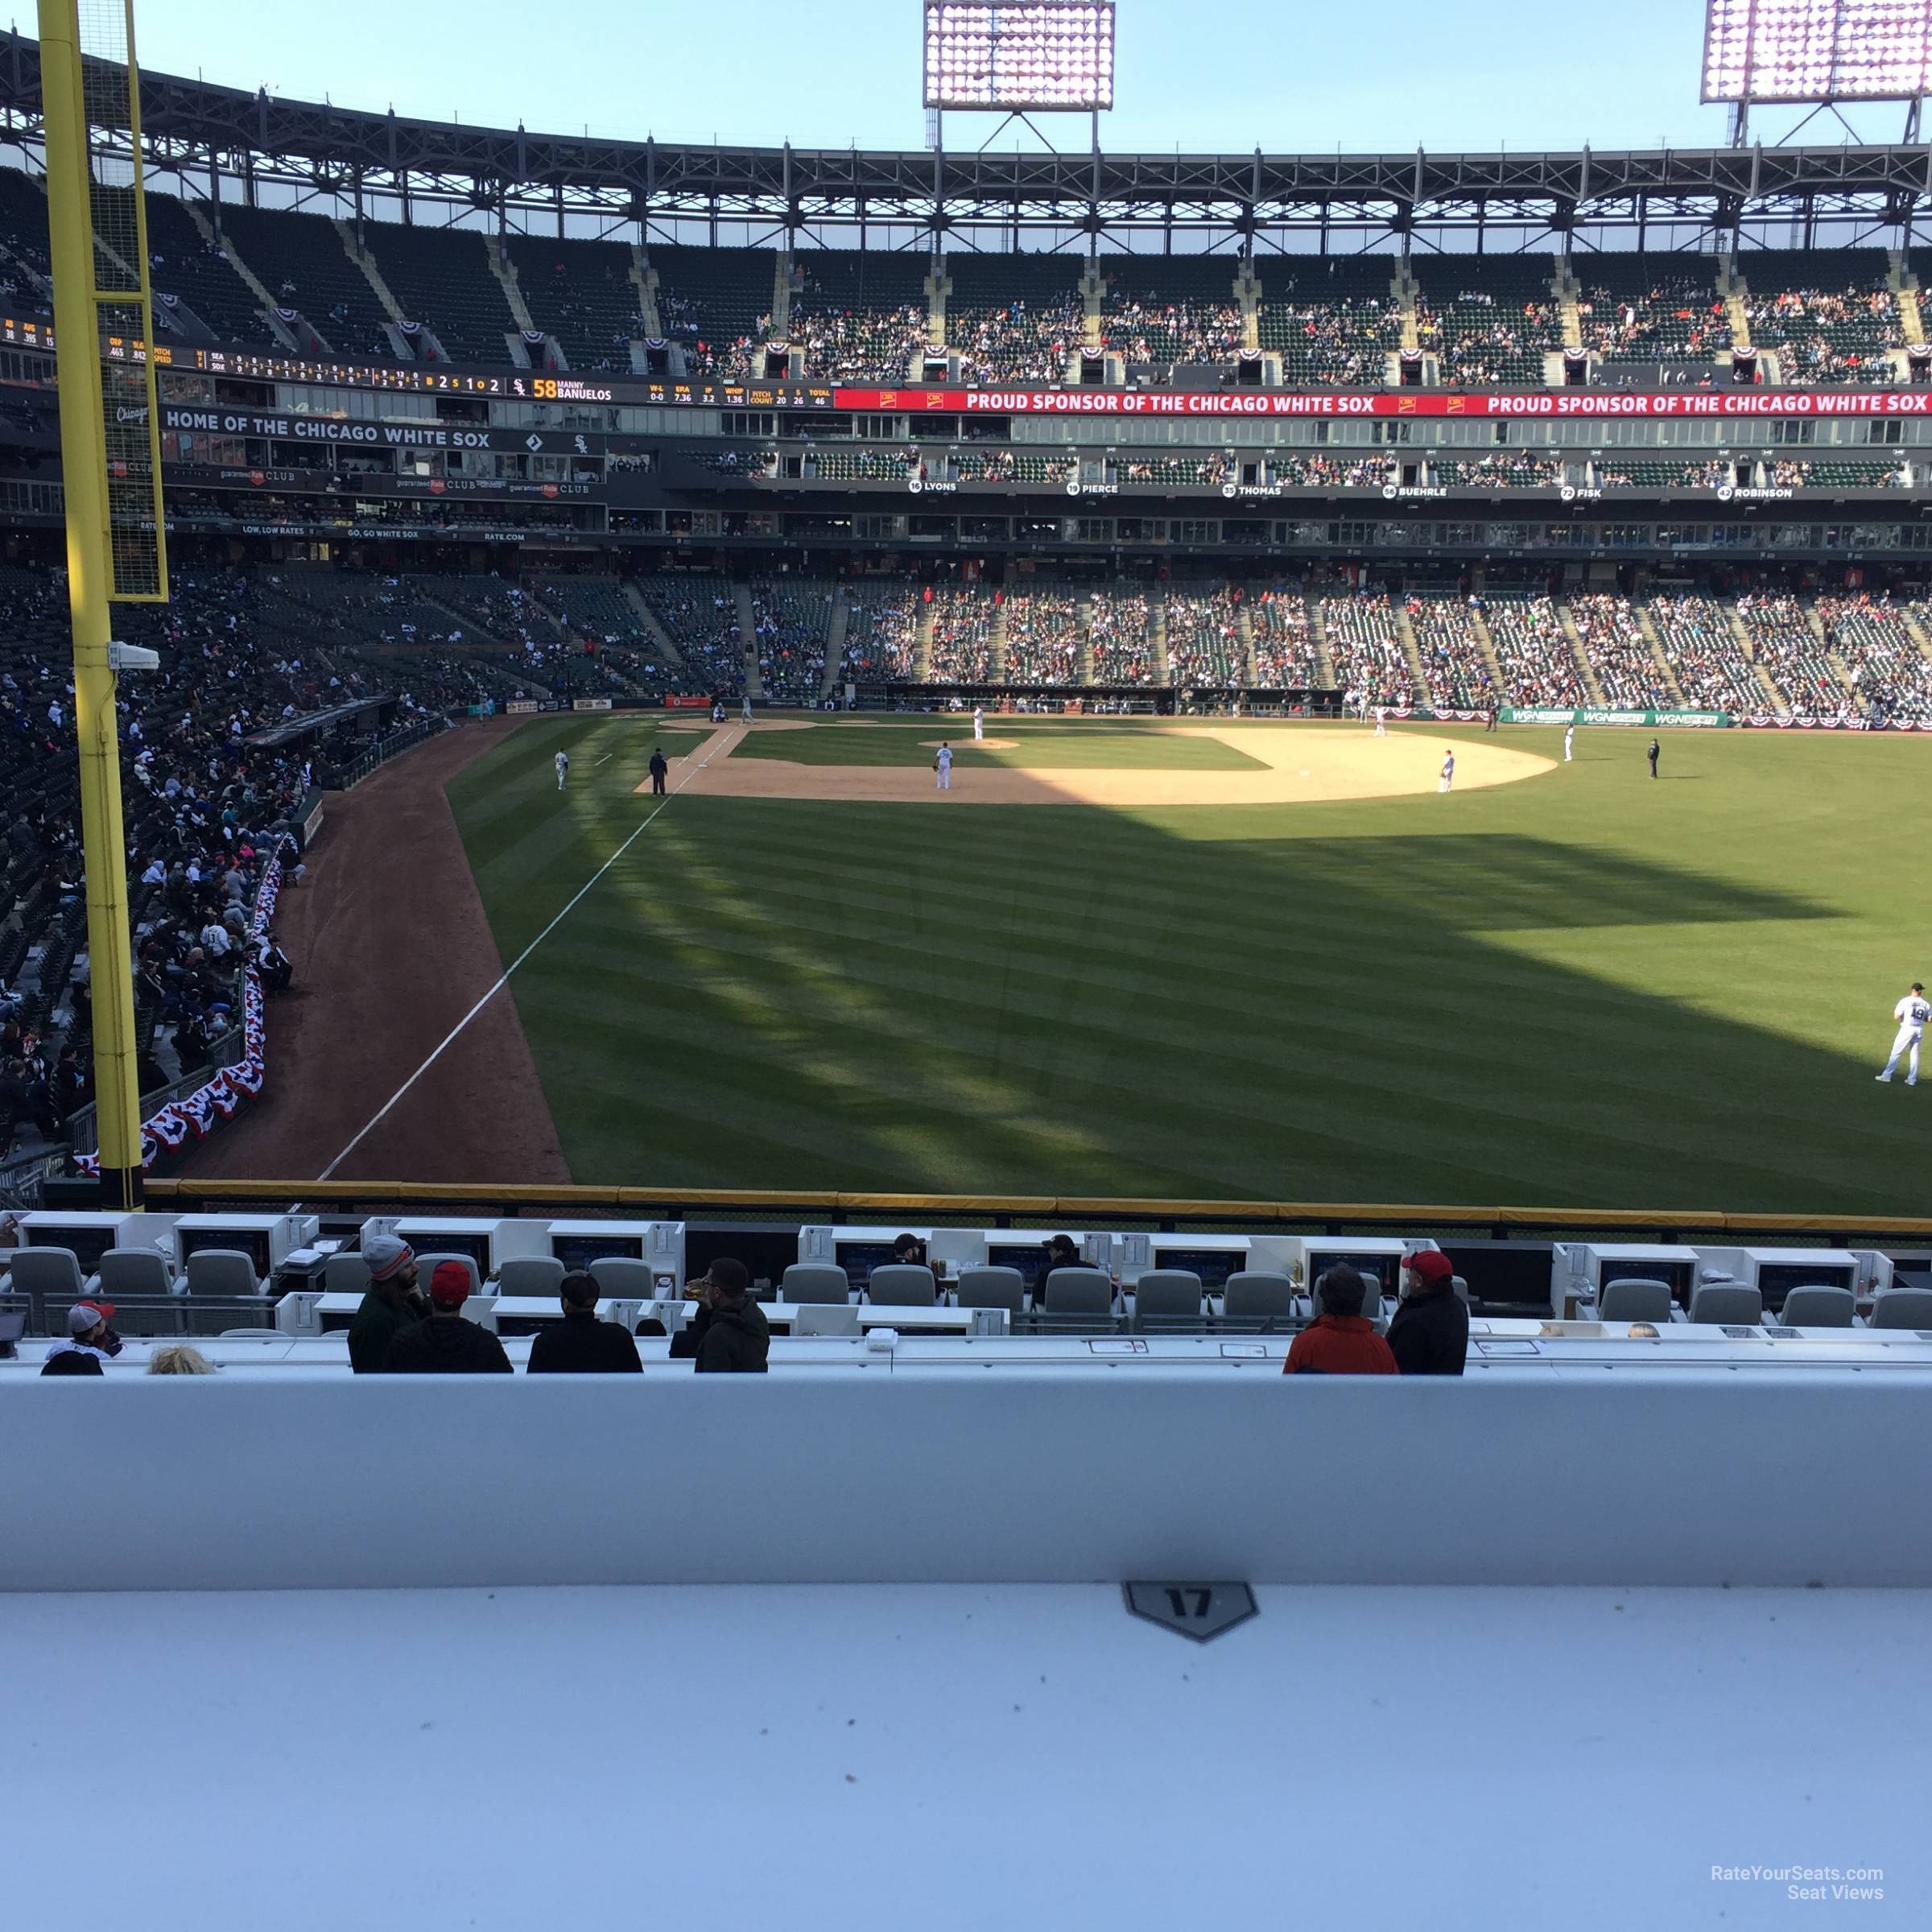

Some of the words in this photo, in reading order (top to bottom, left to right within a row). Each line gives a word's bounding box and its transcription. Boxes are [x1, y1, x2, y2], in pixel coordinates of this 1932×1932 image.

[46, 336, 54, 347] 15
[109, 348, 124, 357] .465
[211, 353, 224, 361] SEA
[426, 377, 433, 386] B
[439, 376, 448, 388] 2
[452, 378, 459, 387] S
[467, 378, 473, 390] 1
[490, 379, 498, 392] 2
[534, 379, 557, 398] 58
[557, 380, 584, 389] MANNY
[557, 389, 612, 401] BANUELOS
[650, 393, 663, 401] 0-0
[675, 394, 691, 402] 7.36
[703, 394, 715, 402] 3.2
[727, 395, 743, 403] 1.36
[967, 394, 1028, 409] PROUD
[1033, 394, 1118, 410] SPONSOR
[1123, 395, 1146, 411] OF
[1150, 395, 1184, 411] THE
[1189, 396, 1268, 411] CHICAGO
[1273, 397, 1332, 411] WHITE
[1337, 397, 1375, 412] SOX
[1488, 397, 1553, 412] PROUD
[1557, 397, 1648, 412] SPONSOR
[1653, 396, 1678, 411] OF
[1682, 396, 1719, 411] THE
[1724, 396, 1811, 411] CHICAGO
[1816, 395, 1882, 411] WHITE
[1887, 395, 1927, 411] SOX
[117, 407, 149, 424] Chicago
[167, 411, 218, 429] HOME
[225, 416, 247, 431] OF
[254, 419, 288, 435] THE
[295, 421, 378, 441] CHICAGO
[384, 428, 447, 445] WHITE
[452, 432, 489, 448] SOX
[266, 471, 295, 481] CLUB
[447, 481, 476, 489] CLUB
[560, 485, 589, 493] CLUB
[924, 482, 956, 491] LYONS
[1082, 485, 1118, 493] PIERCE
[1239, 487, 1282, 495] THOMAS
[1399, 488, 1447, 497] BUEHRLE
[1577, 489, 1601, 497] FISK
[1735, 489, 1792, 497] ROBINSON
[243, 526, 261, 535] LOW,
[280, 527, 304, 535] RATES
[348, 530, 362, 539] GO,
[363, 530, 374, 538] GO
[1513, 711, 1540, 720] WGN
[1583, 712, 1610, 721] WGN
[1655, 714, 1684, 724] WGN
[1165, 1588, 1212, 1617] 17
